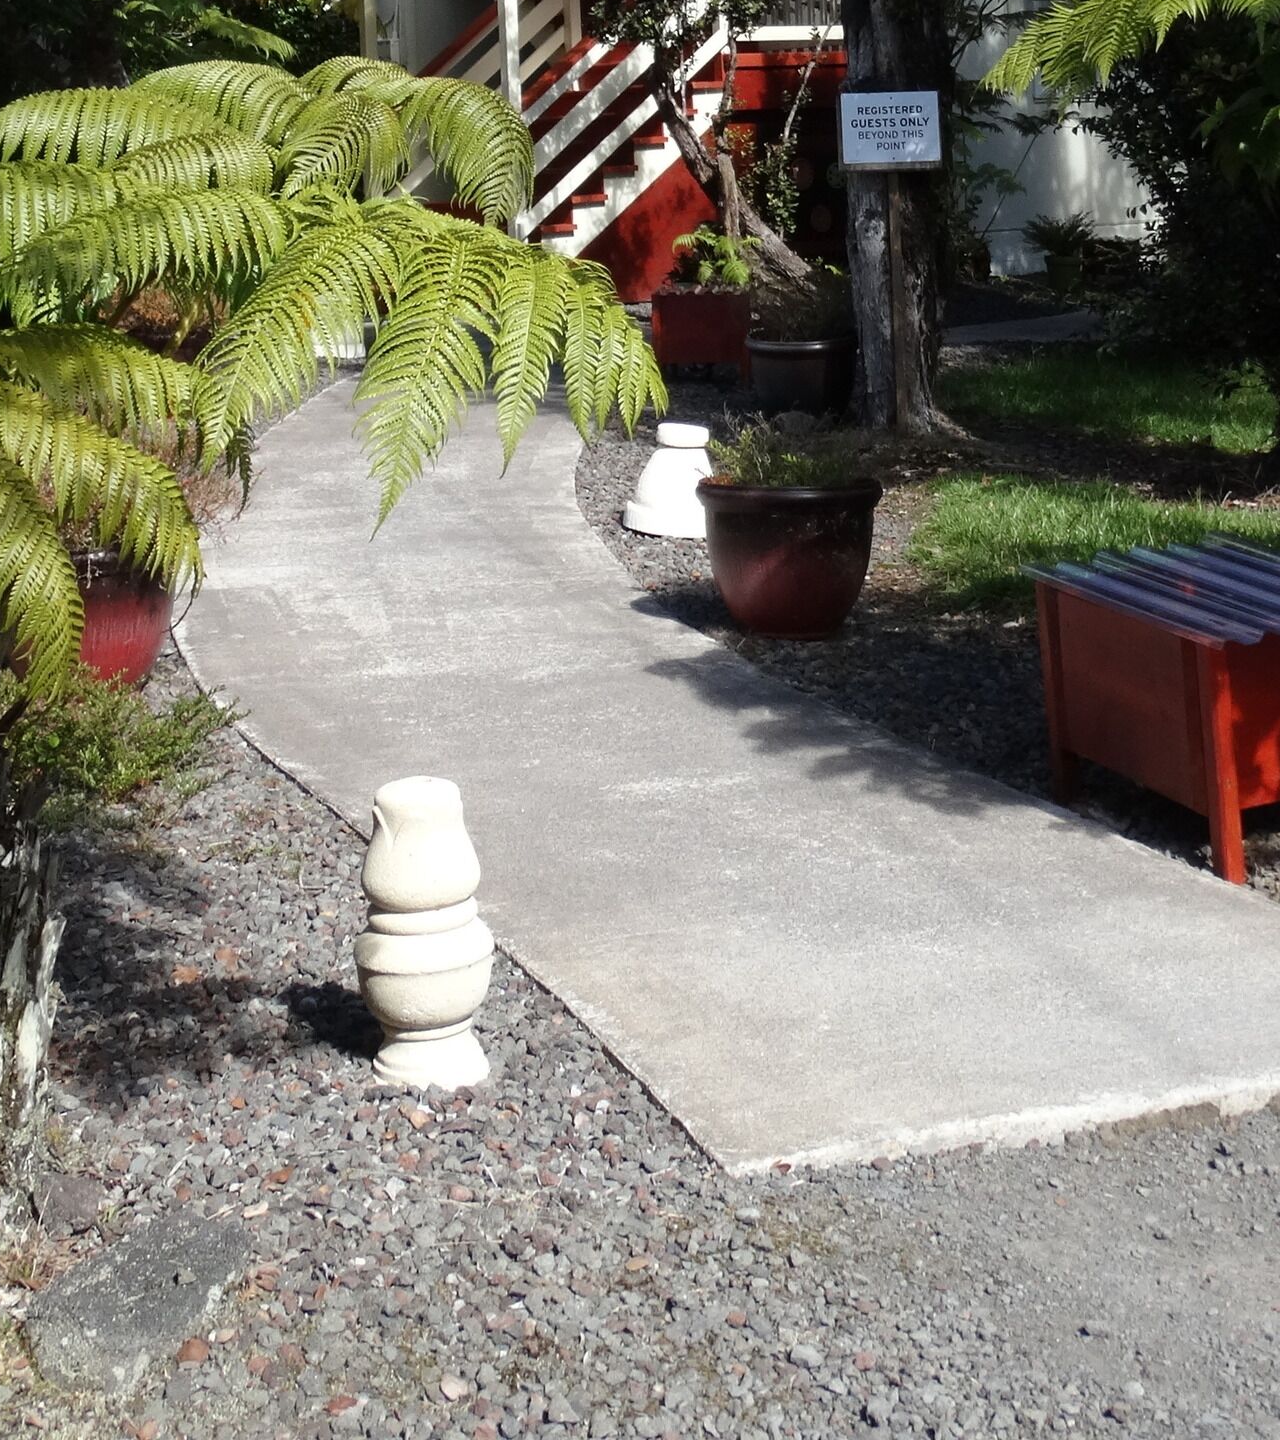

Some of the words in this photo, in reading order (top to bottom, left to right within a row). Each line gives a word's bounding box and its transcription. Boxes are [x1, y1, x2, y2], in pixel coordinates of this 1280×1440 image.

[857, 105, 923, 115] REGISTERED
[851, 118, 896, 128] GUESTS
[900, 117, 930, 127] ONLY
[858, 130, 899, 140] BEYOND
[901, 129, 924, 138] THIS
[876, 141, 906, 150] POINT
